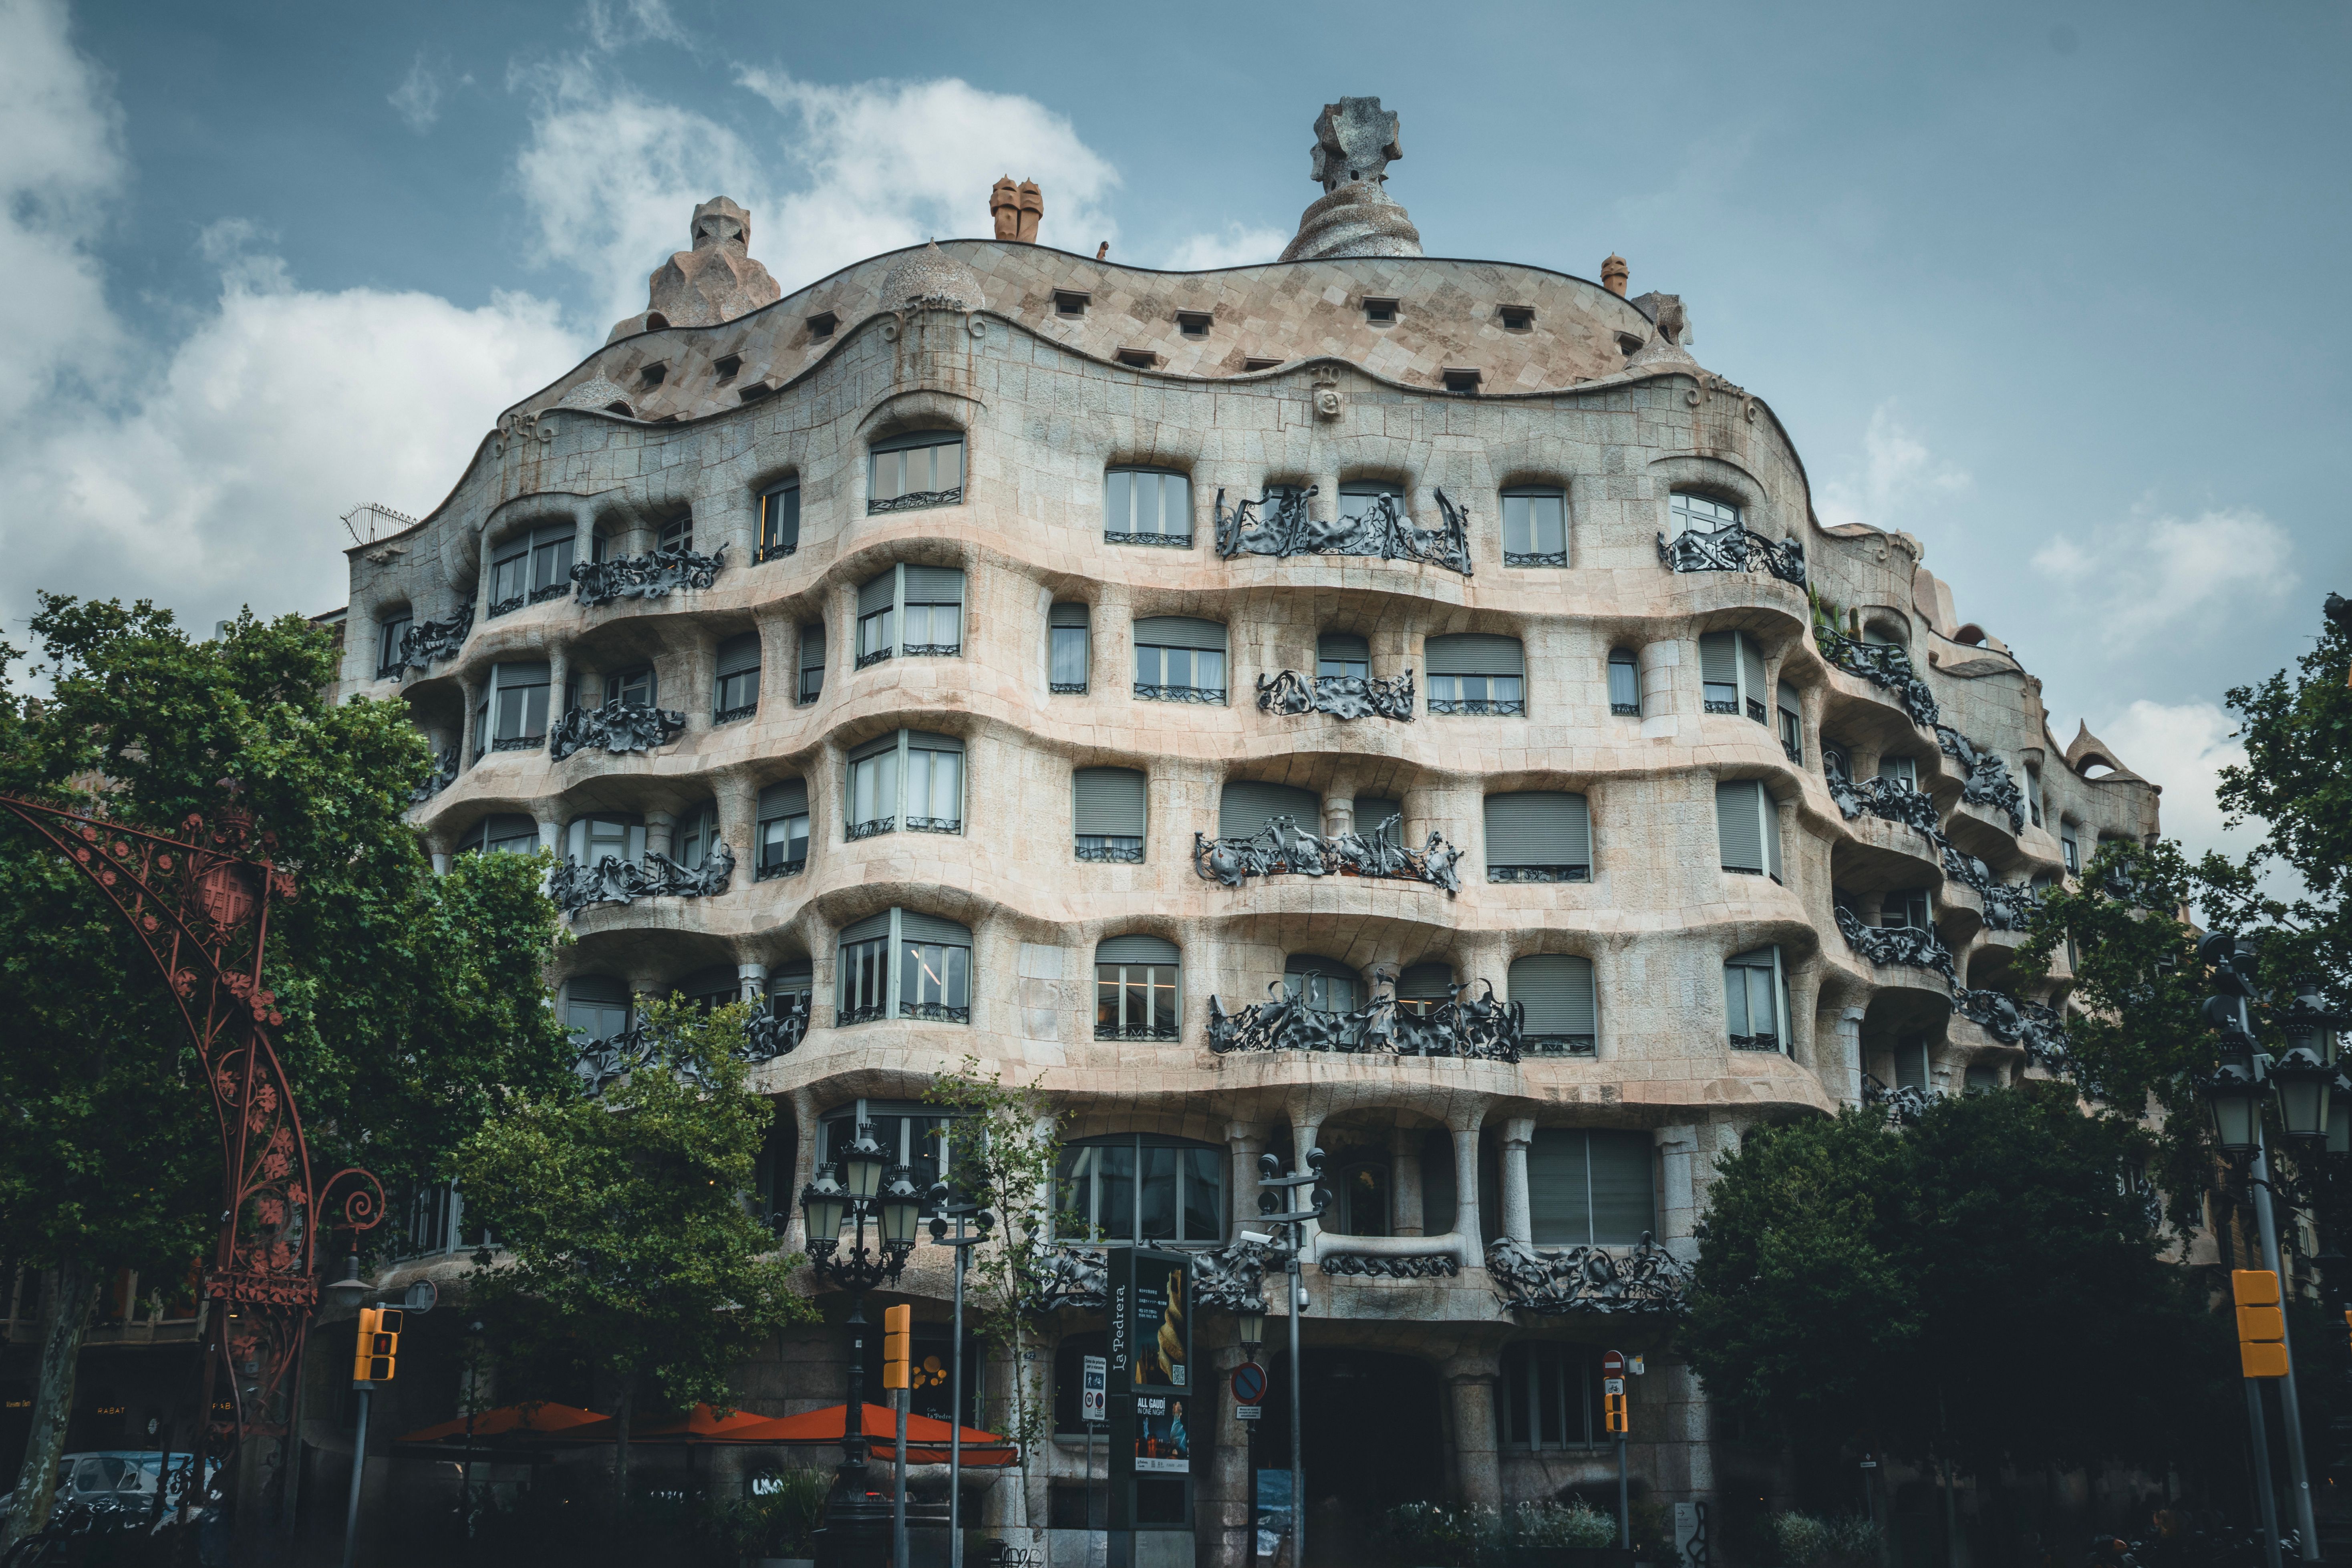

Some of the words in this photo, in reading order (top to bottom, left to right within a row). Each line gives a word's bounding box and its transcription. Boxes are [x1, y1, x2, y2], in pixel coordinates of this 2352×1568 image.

[1113, 1284, 1125, 1352] Pedrera
[1113, 1353, 1127, 1371] La
[1138, 1397, 1148, 1407] ALL
[1149, 1397, 1165, 1409] GAUDÍ
